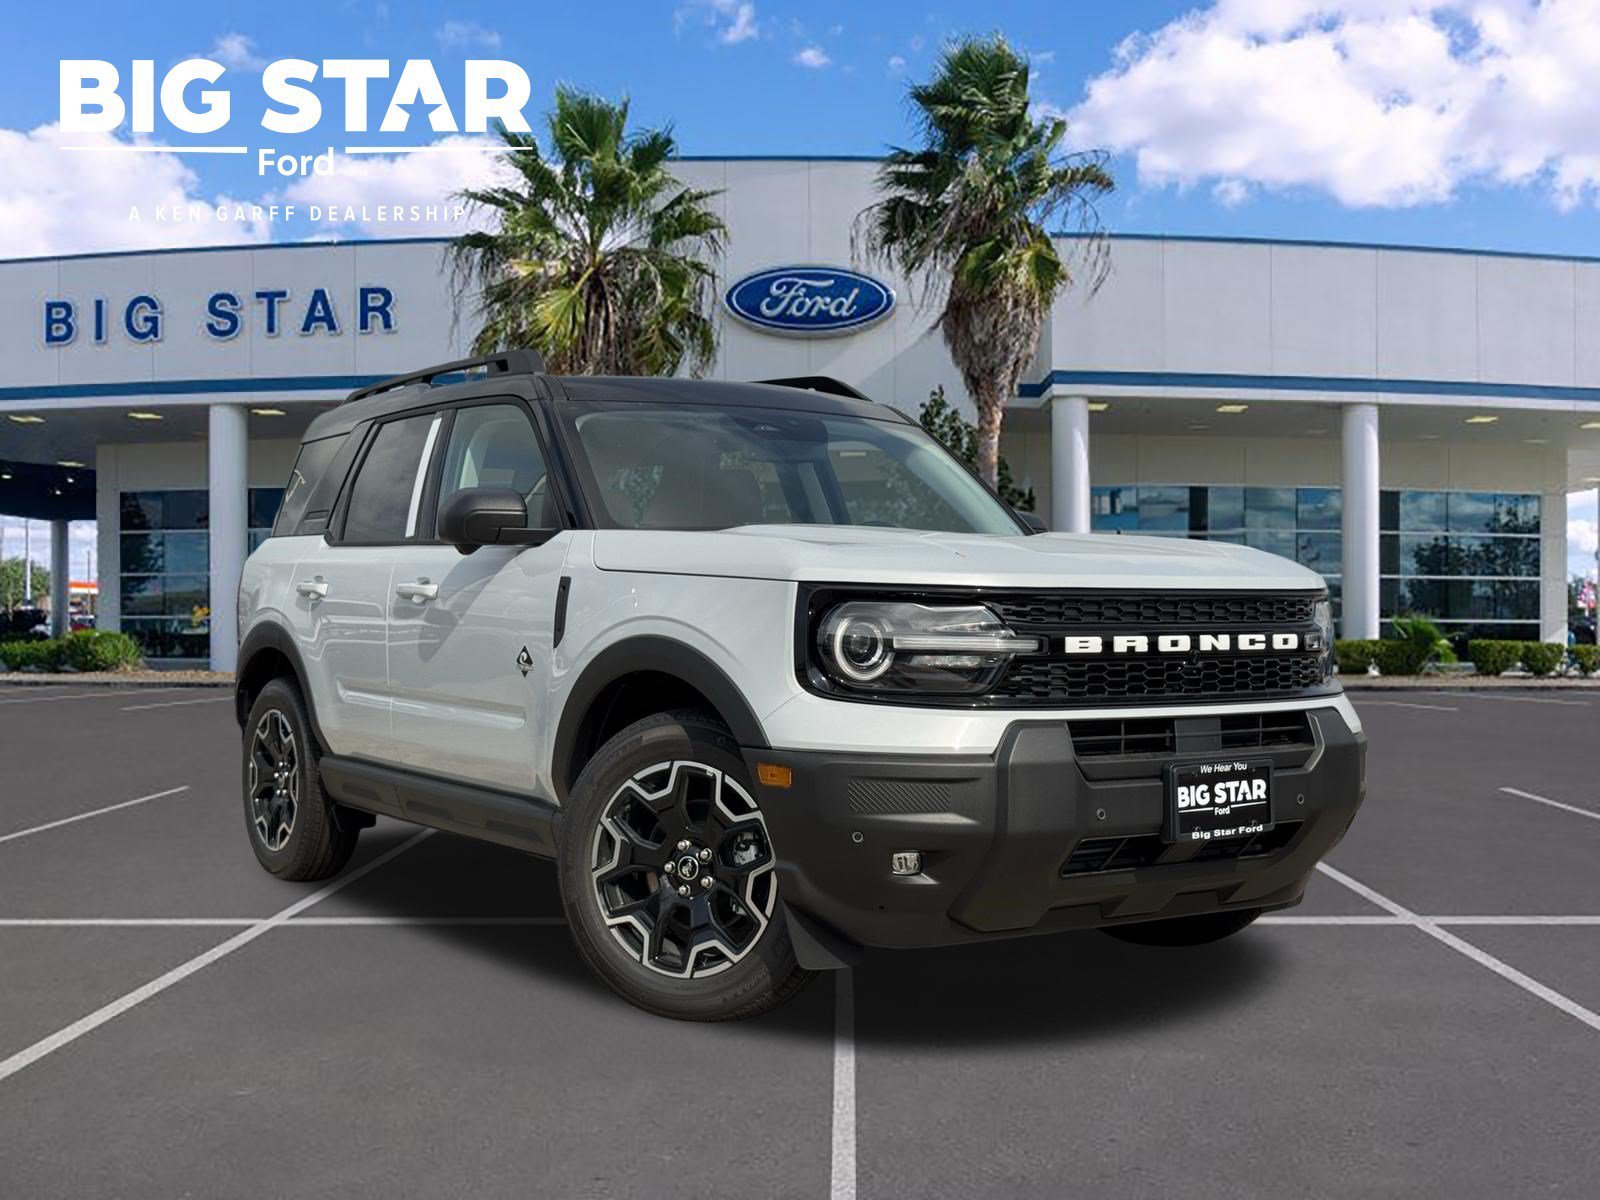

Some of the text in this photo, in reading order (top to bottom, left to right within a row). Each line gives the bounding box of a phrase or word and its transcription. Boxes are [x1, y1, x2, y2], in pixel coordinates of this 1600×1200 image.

[760, 277, 860, 318] Ford
[44, 286, 397, 345] BIG STAR
[1064, 633, 1299, 654] BRONCO
[1200, 762, 1248, 774] We Hear You
[1177, 778, 1267, 809] BIG STAR
[1214, 805, 1231, 816] Ford
[1191, 824, 1264, 840] Big Star Ford
